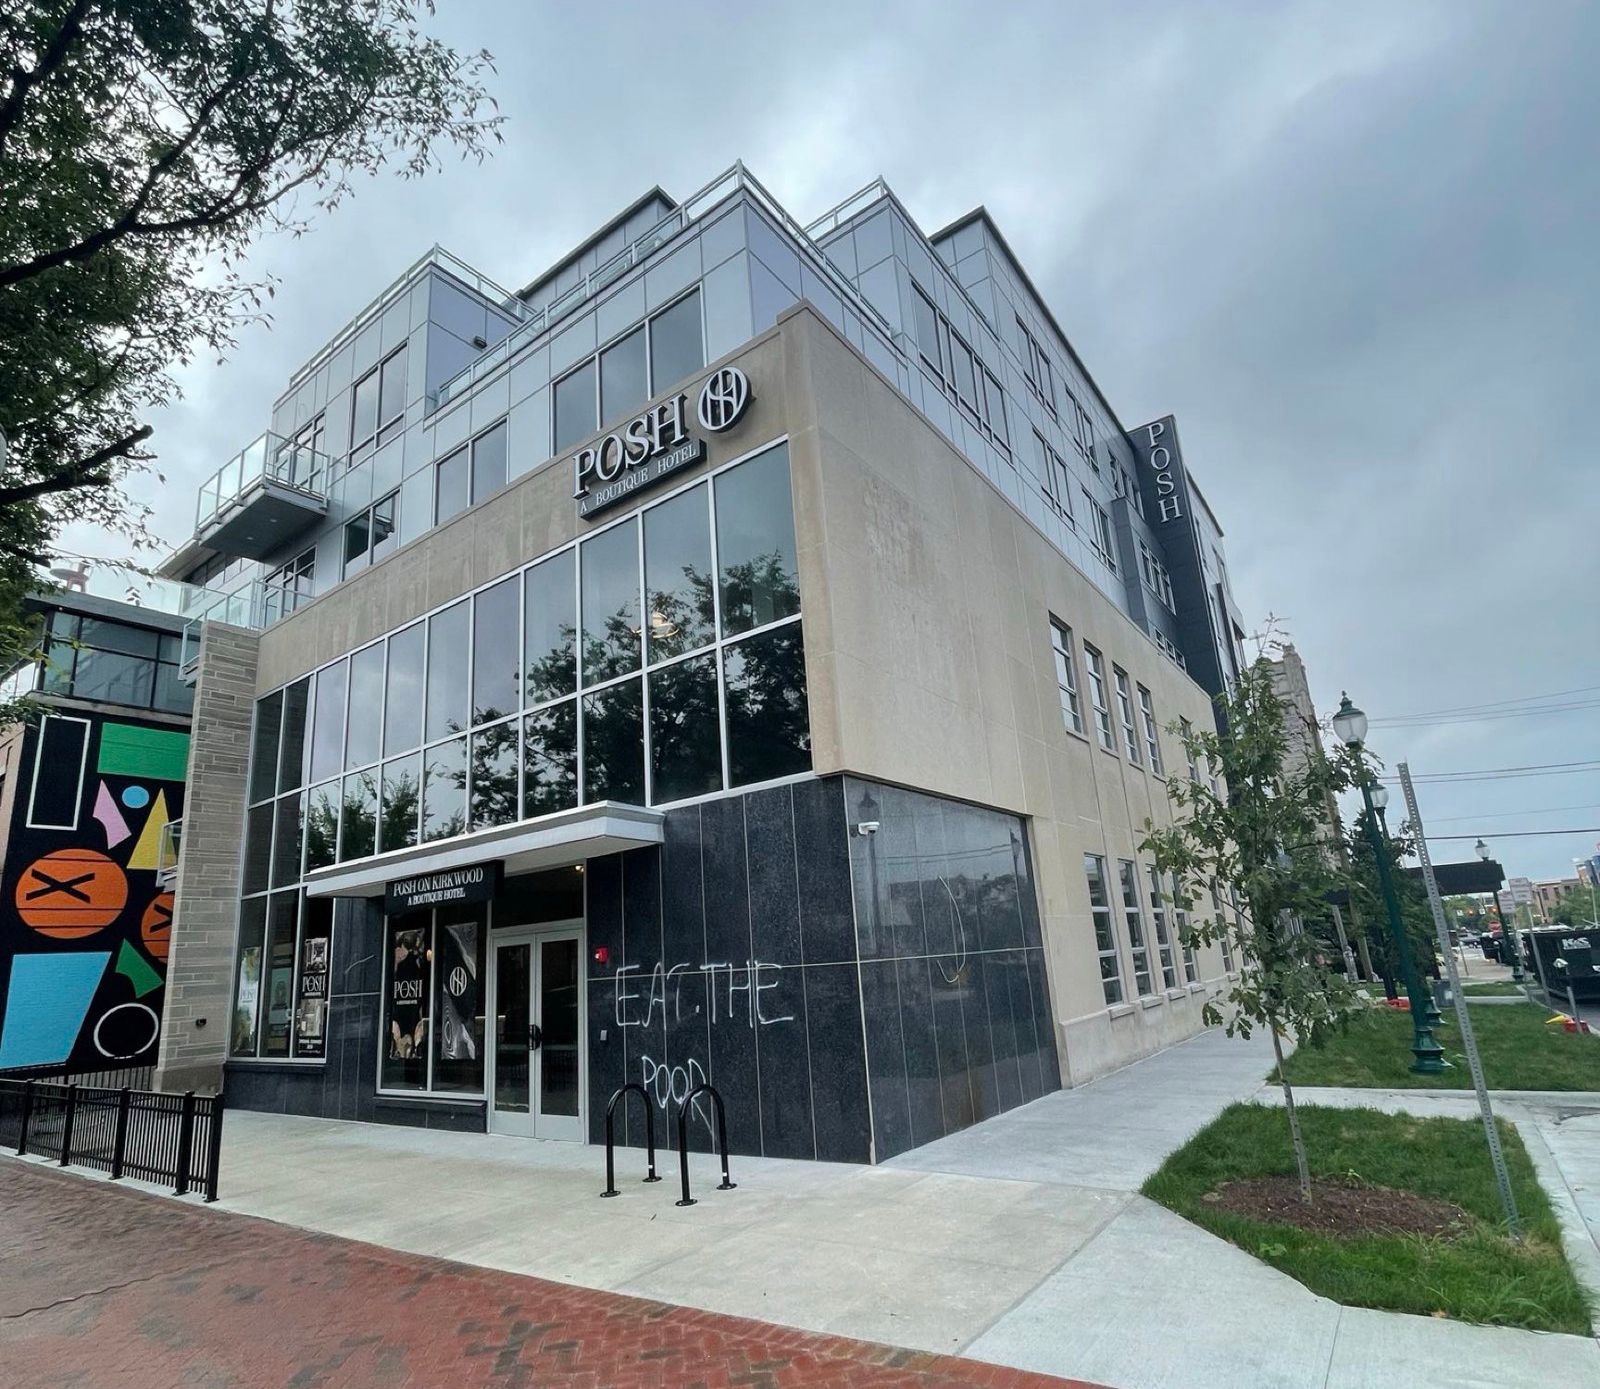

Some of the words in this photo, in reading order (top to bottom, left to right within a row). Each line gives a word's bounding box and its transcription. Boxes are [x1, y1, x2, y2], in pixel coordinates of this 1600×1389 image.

[573, 393, 688, 499] POSH
[580, 500, 588, 514] A
[596, 467, 649, 506] BOUTIQUE
[657, 445, 697, 474] HOTEL
[1146, 422, 1183, 523] POSH
[393, 880, 417, 897] POSH
[417, 876, 431, 892] ON
[432, 867, 484, 890] KIRKWOOD
[407, 896, 412, 906] A
[413, 890, 443, 905] BOUTIQUE
[443, 887, 466, 900] HOTEL
[302, 975, 326, 992] POSH
[393, 980, 423, 999] POSH
[700, 960, 794, 1029] THE
[641, 1056, 714, 1135] POOR
